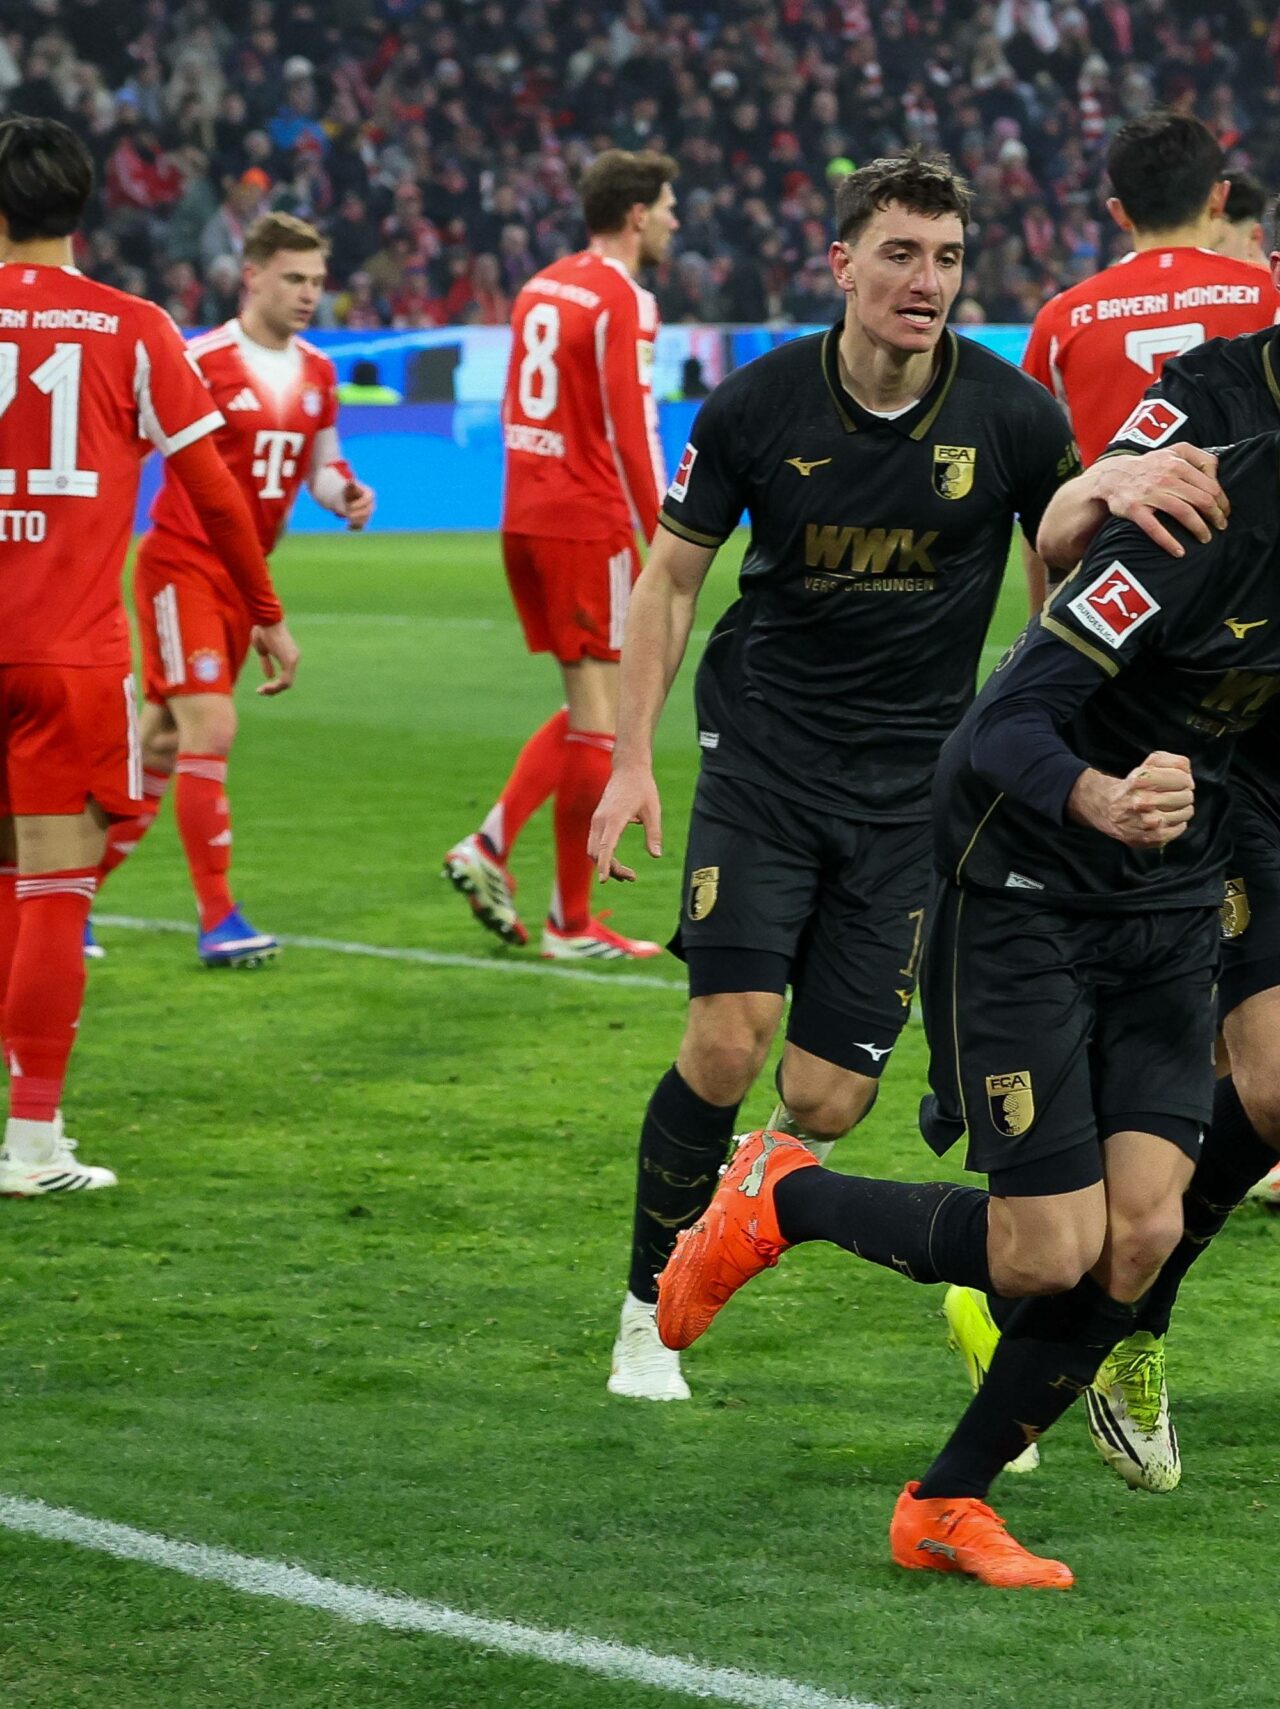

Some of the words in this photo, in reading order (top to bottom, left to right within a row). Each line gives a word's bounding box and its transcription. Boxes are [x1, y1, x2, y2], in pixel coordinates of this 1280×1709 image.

[1070, 303, 1093, 327] FC
[1096, 293, 1169, 320] BAYERN
[518, 303, 560, 420] 8
[252, 430, 304, 499] T
[939, 448, 971, 461] FCA
[804, 523, 940, 573] WWK
[1076, 602, 1116, 644] BUNDESLIGA
[991, 1075, 1026, 1090] FCA
